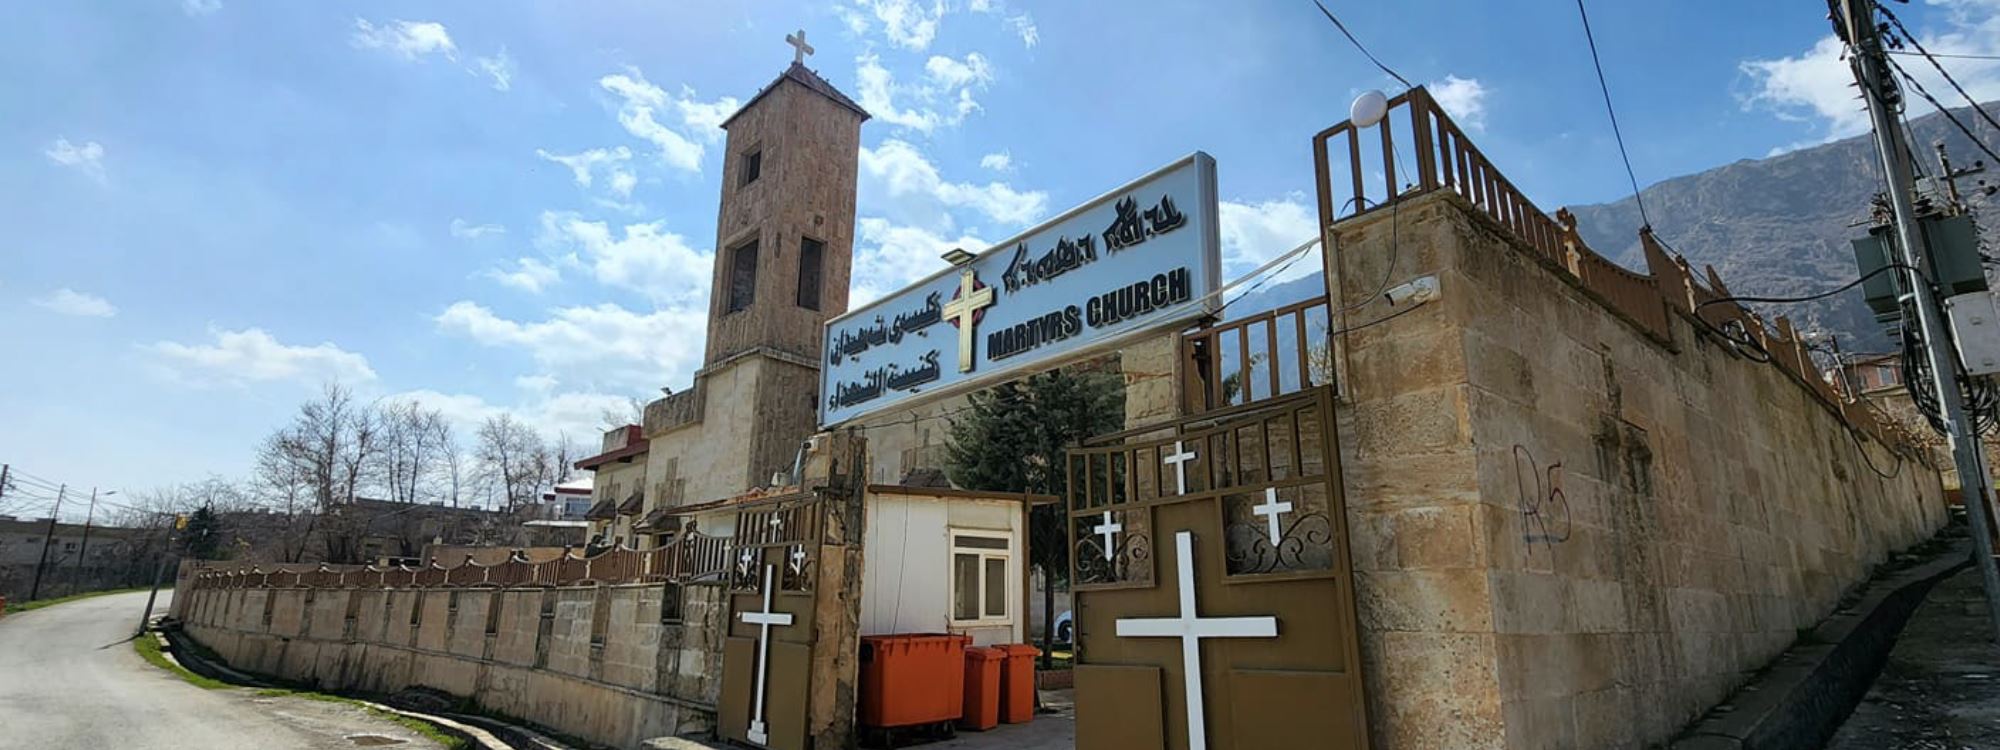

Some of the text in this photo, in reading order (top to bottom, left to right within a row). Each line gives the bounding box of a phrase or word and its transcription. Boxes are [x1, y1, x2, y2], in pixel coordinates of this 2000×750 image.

[987, 267, 1187, 361] MARTYRS CHURCH
[828, 349, 940, 411] كنيسة الشهداء
